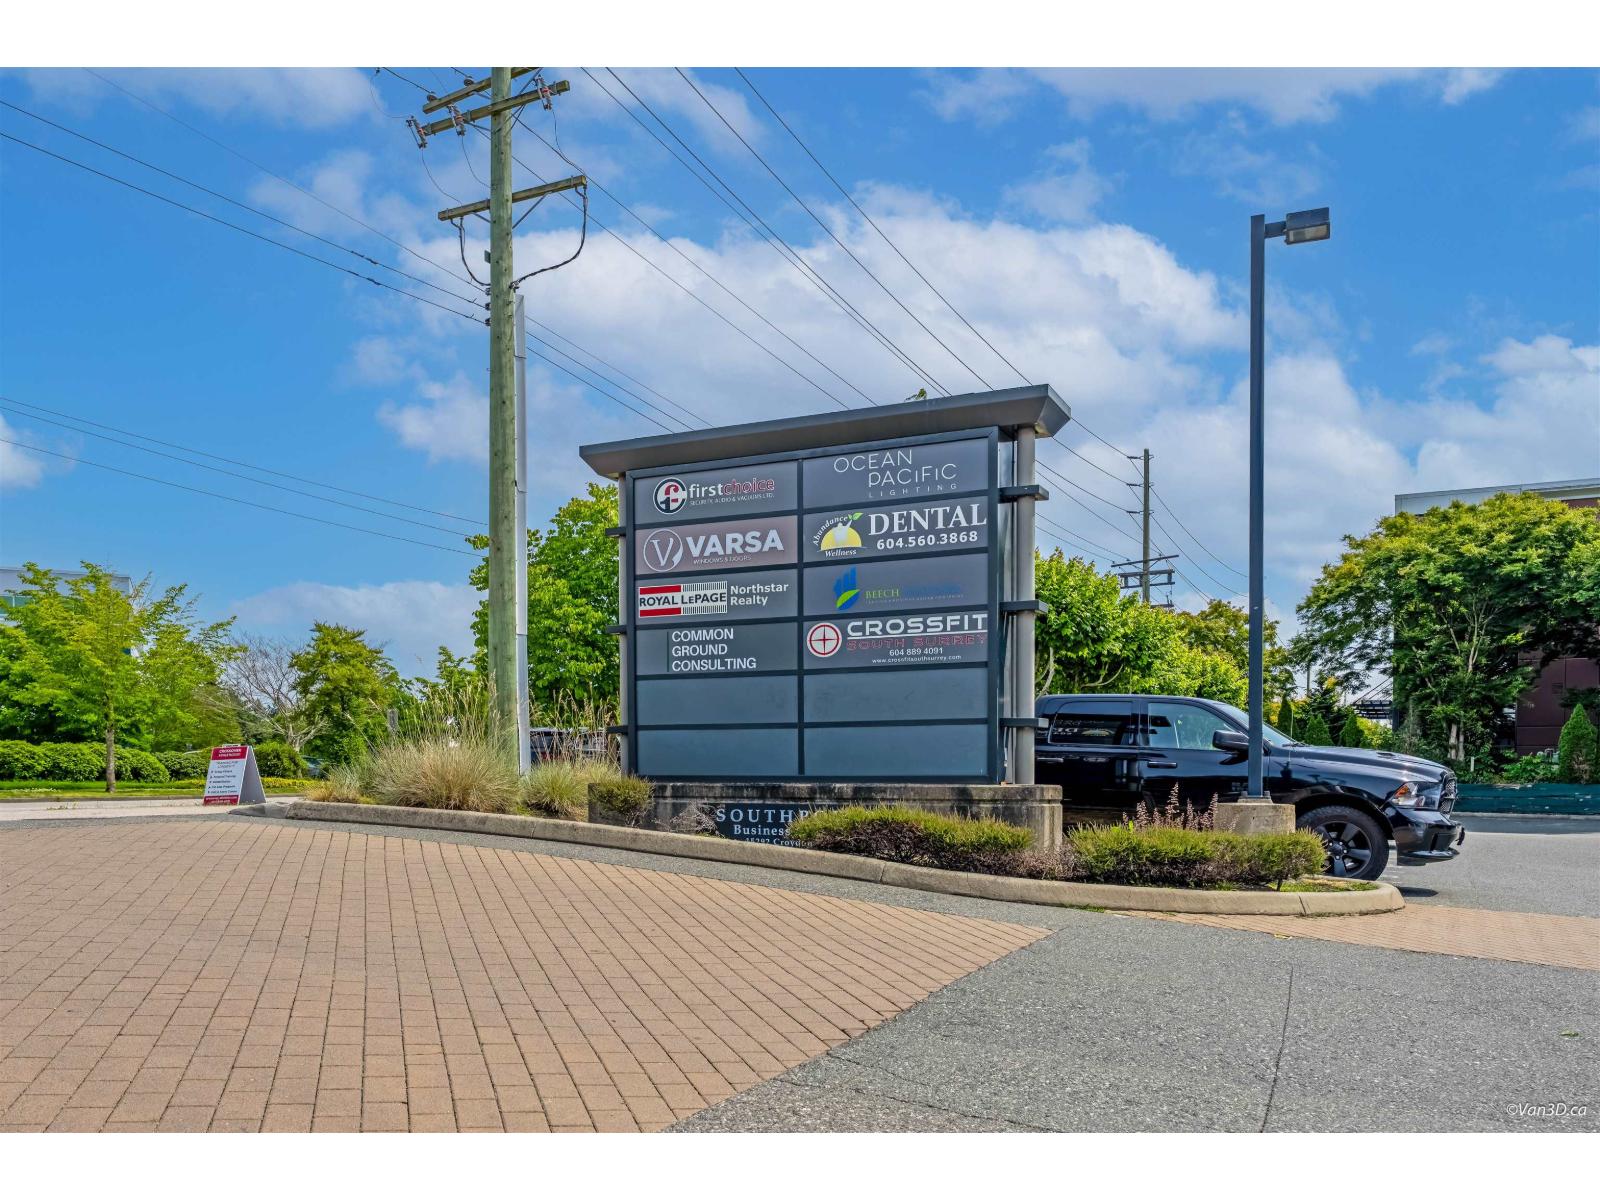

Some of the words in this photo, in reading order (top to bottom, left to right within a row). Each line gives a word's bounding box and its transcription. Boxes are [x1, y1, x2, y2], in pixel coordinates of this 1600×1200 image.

[834, 450, 912, 473] OCEAN
[868, 464, 957, 487] PACIFIC
[689, 478, 775, 498] firstchoice
[868, 483, 957, 498] LIGHTING
[868, 503, 987, 536] DENTAL
[813, 516, 848, 546] Abundance
[686, 529, 784, 557] VARSA
[876, 530, 978, 550] 604.560.3868
[825, 549, 857, 558] Wellness
[693, 557, 724, 565] WINDOWS
[730, 583, 789, 595] Northstar
[639, 595, 678, 607] ROYAL
[730, 595, 768, 606] Realty
[847, 613, 988, 637] CROSSFIT
[672, 628, 734, 642] COMMON
[672, 644, 728, 657] GROUND
[846, 637, 905, 651] SOUTH
[906, 648, 922, 656] 889
[923, 647, 943, 655] 4091
[672, 658, 757, 672] CONSULTING
[733, 824, 791, 836] Business
